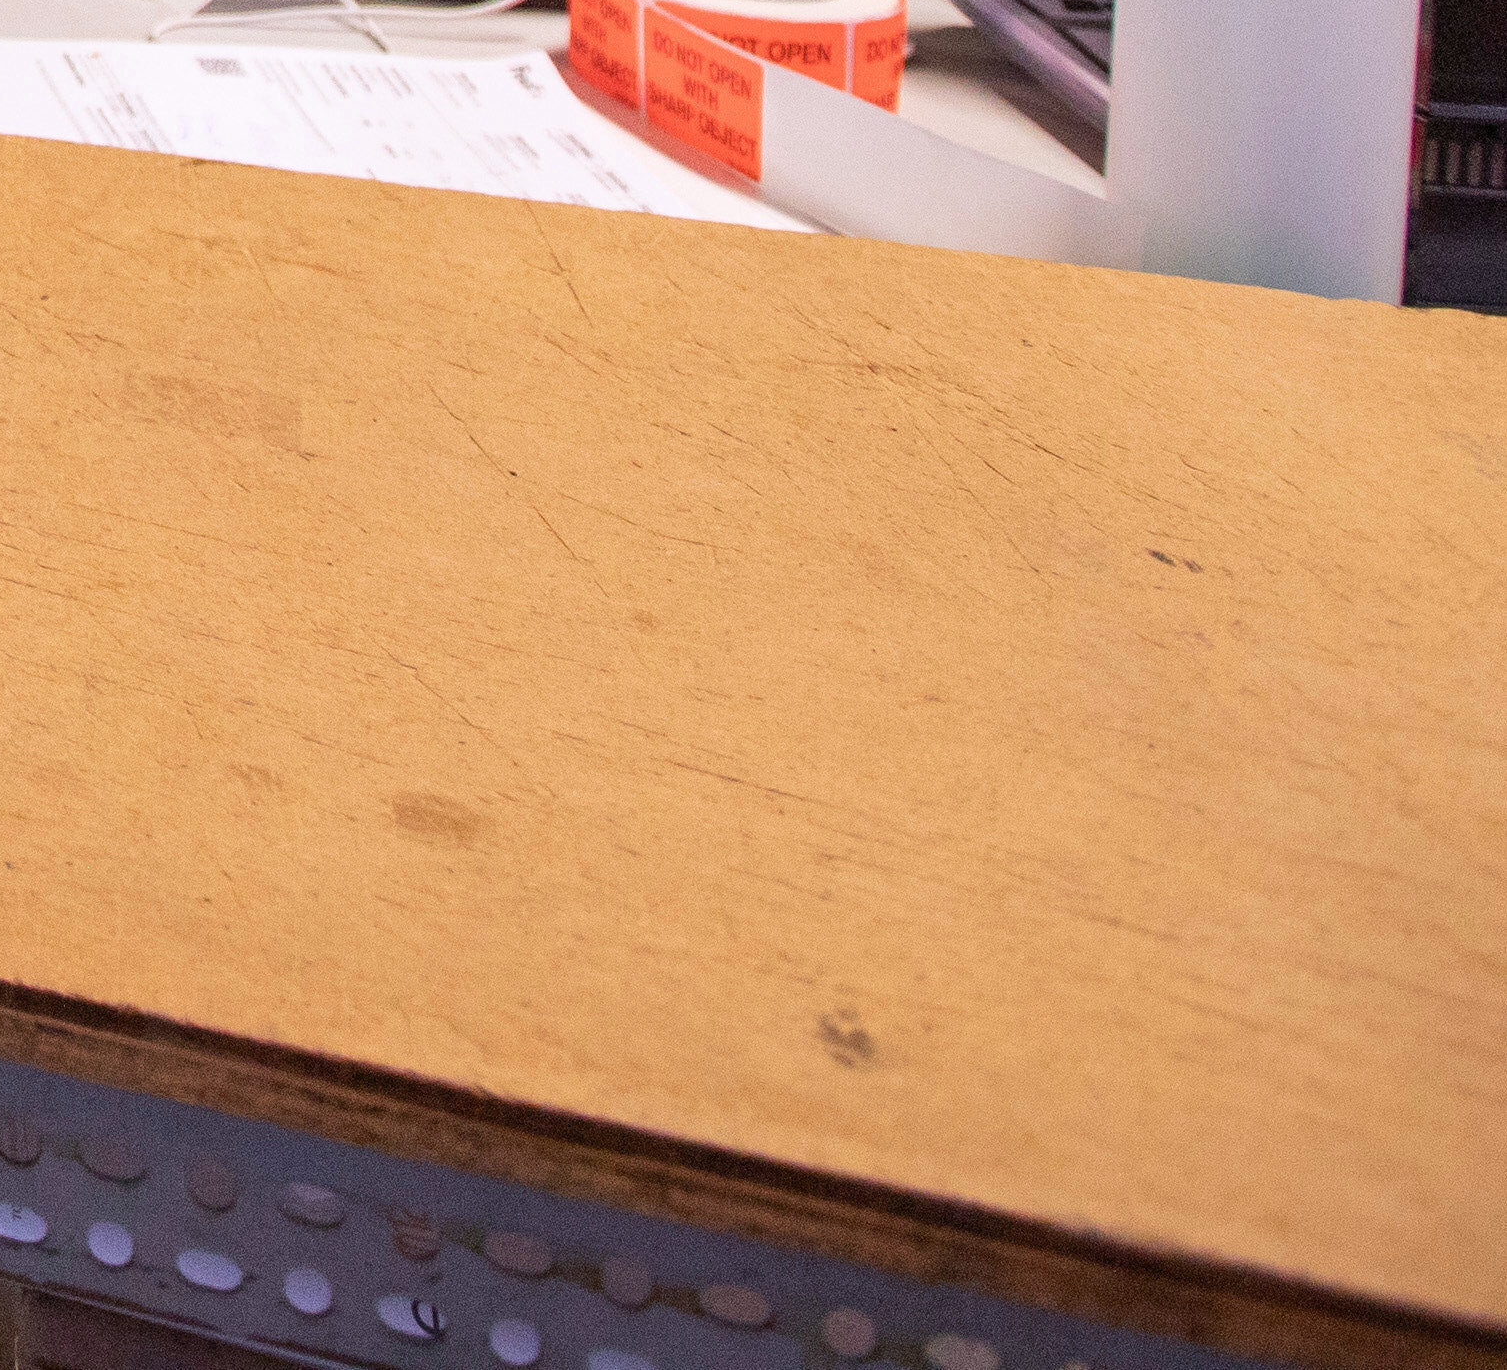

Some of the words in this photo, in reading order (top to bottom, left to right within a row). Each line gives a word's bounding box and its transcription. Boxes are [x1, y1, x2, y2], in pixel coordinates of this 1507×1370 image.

[652, 30, 674, 58] DO
[676, 41, 704, 75] NOT
[708, 61, 753, 100] OPEN
[767, 40, 833, 64] OPEN
[683, 74, 719, 110] WITH
[699, 111, 757, 161] OBJECT
